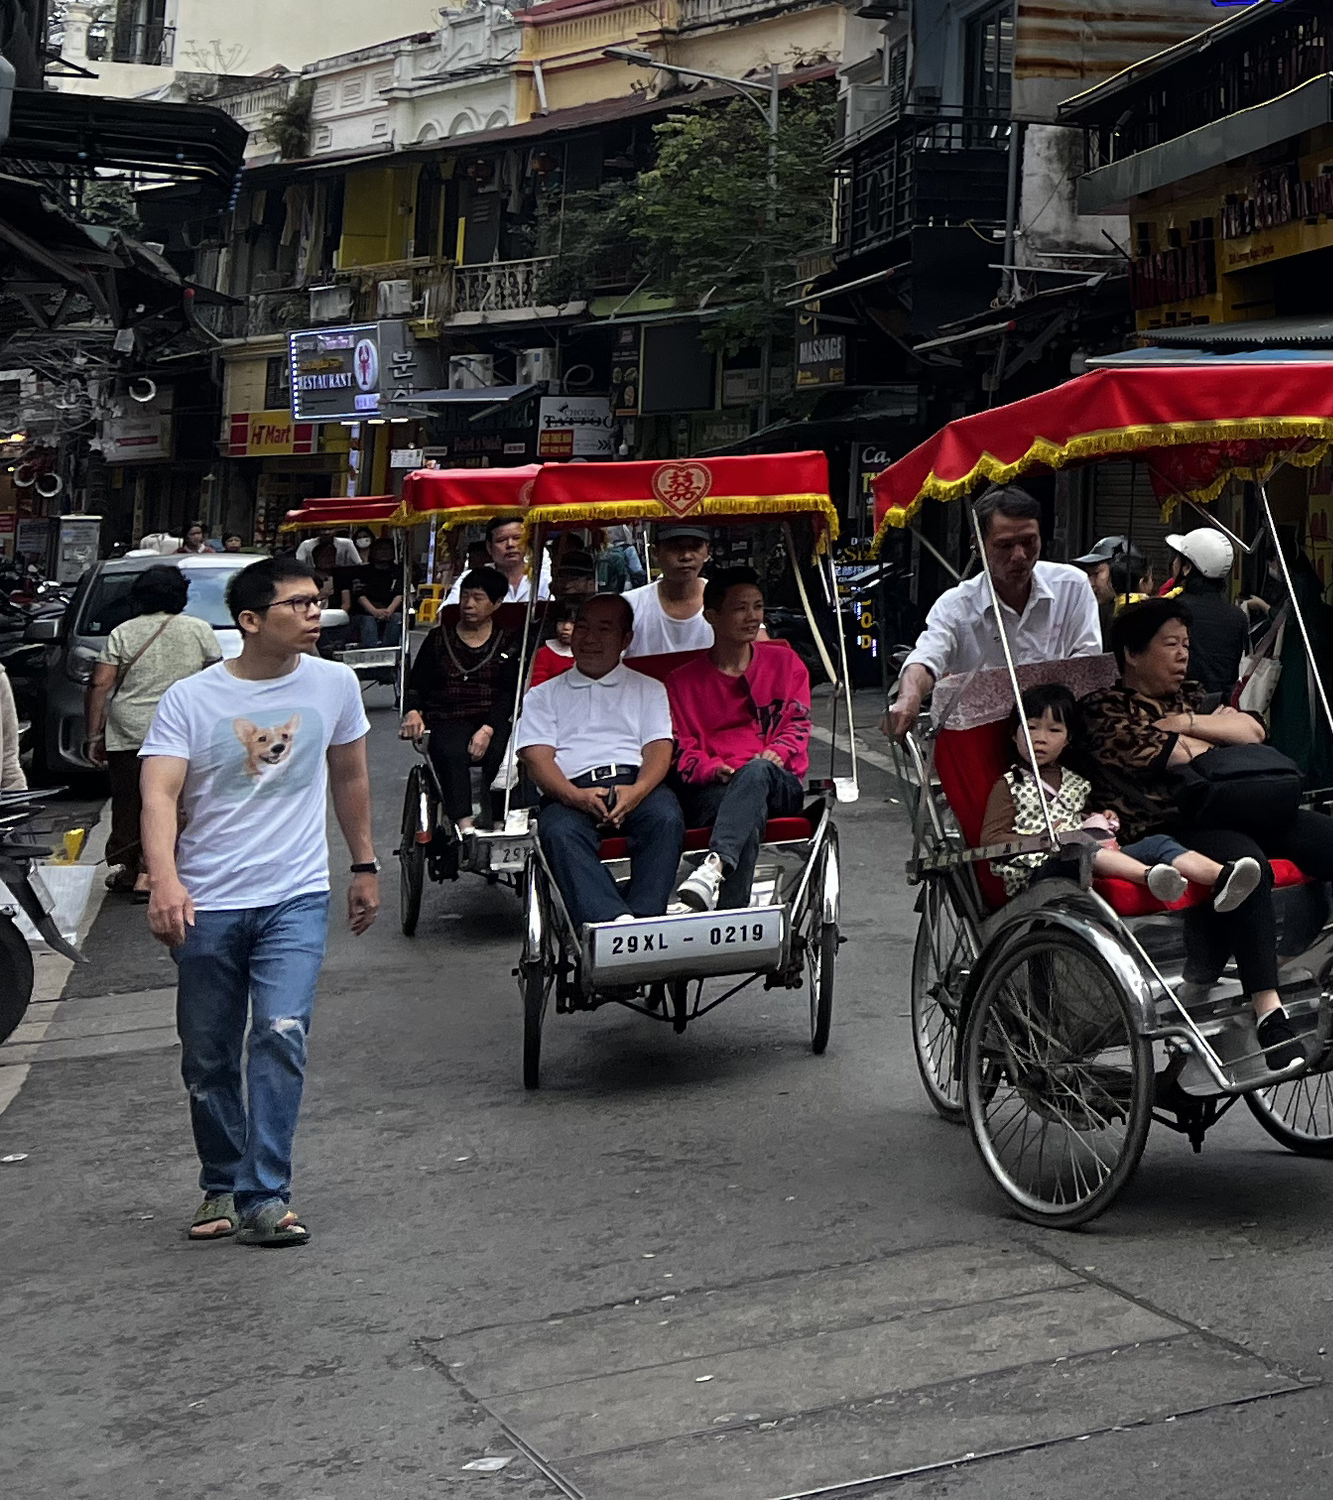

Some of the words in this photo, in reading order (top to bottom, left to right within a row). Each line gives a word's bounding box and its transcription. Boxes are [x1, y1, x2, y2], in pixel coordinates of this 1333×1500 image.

[799, 336, 842, 364] MASSAGE
[612, 933, 669, 955] 29XL
[710, 924, 764, 946] 0219
